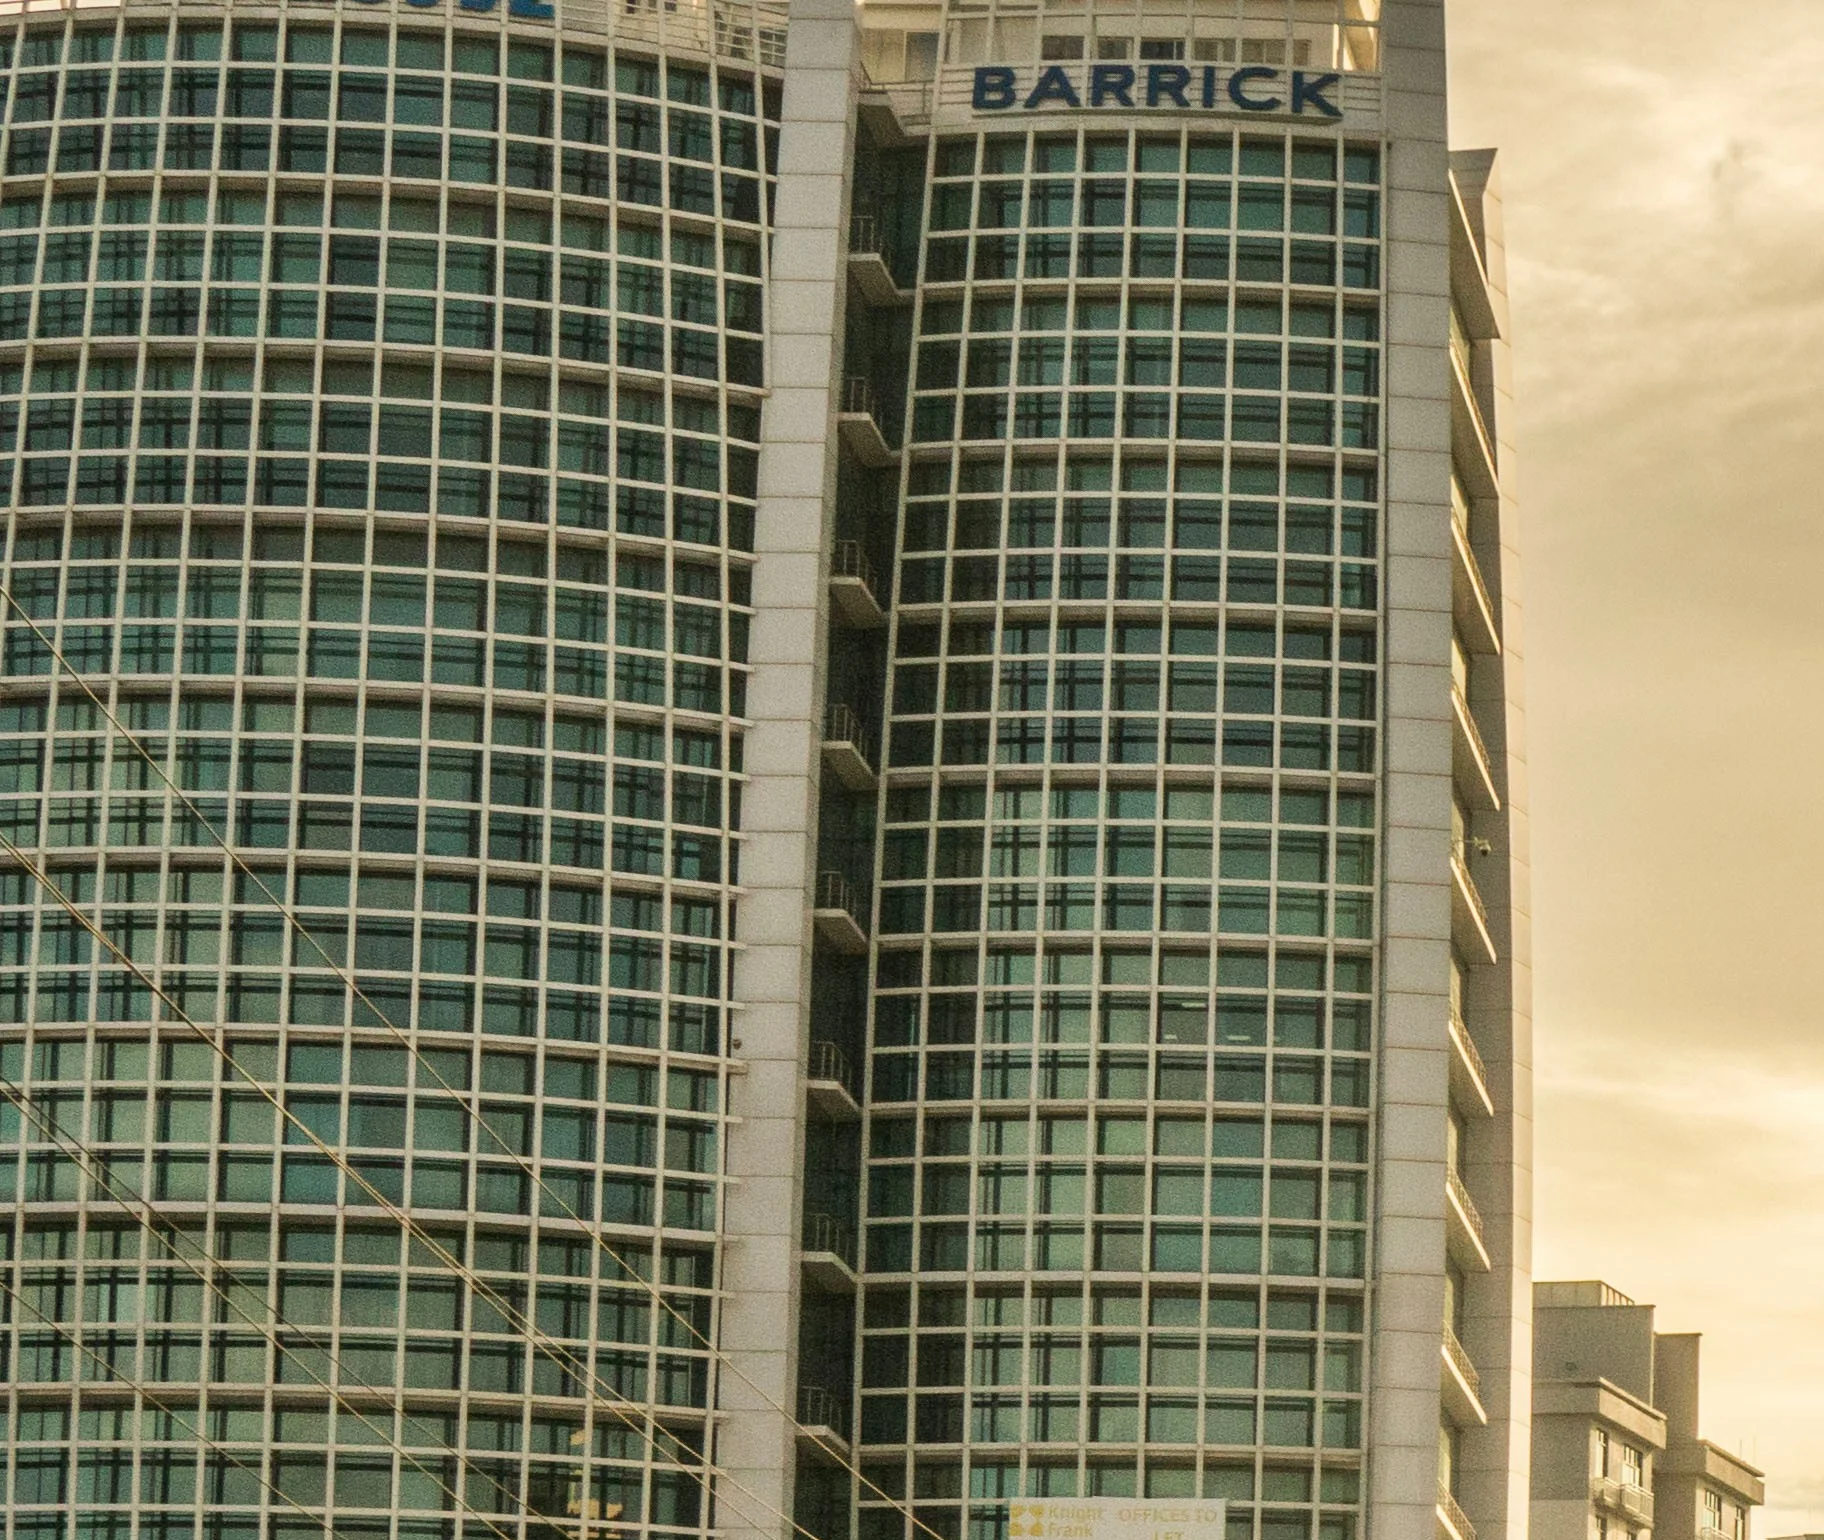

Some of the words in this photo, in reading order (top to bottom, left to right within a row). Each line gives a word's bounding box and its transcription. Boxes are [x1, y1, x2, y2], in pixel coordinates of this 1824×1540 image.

[973, 65, 1343, 118] BARRICK
[1048, 1505, 1104, 1522] Knight
[1118, 1508, 1189, 1523] OFFICES
[1195, 1509, 1218, 1523] TO
[1048, 1522, 1094, 1538] Frank
